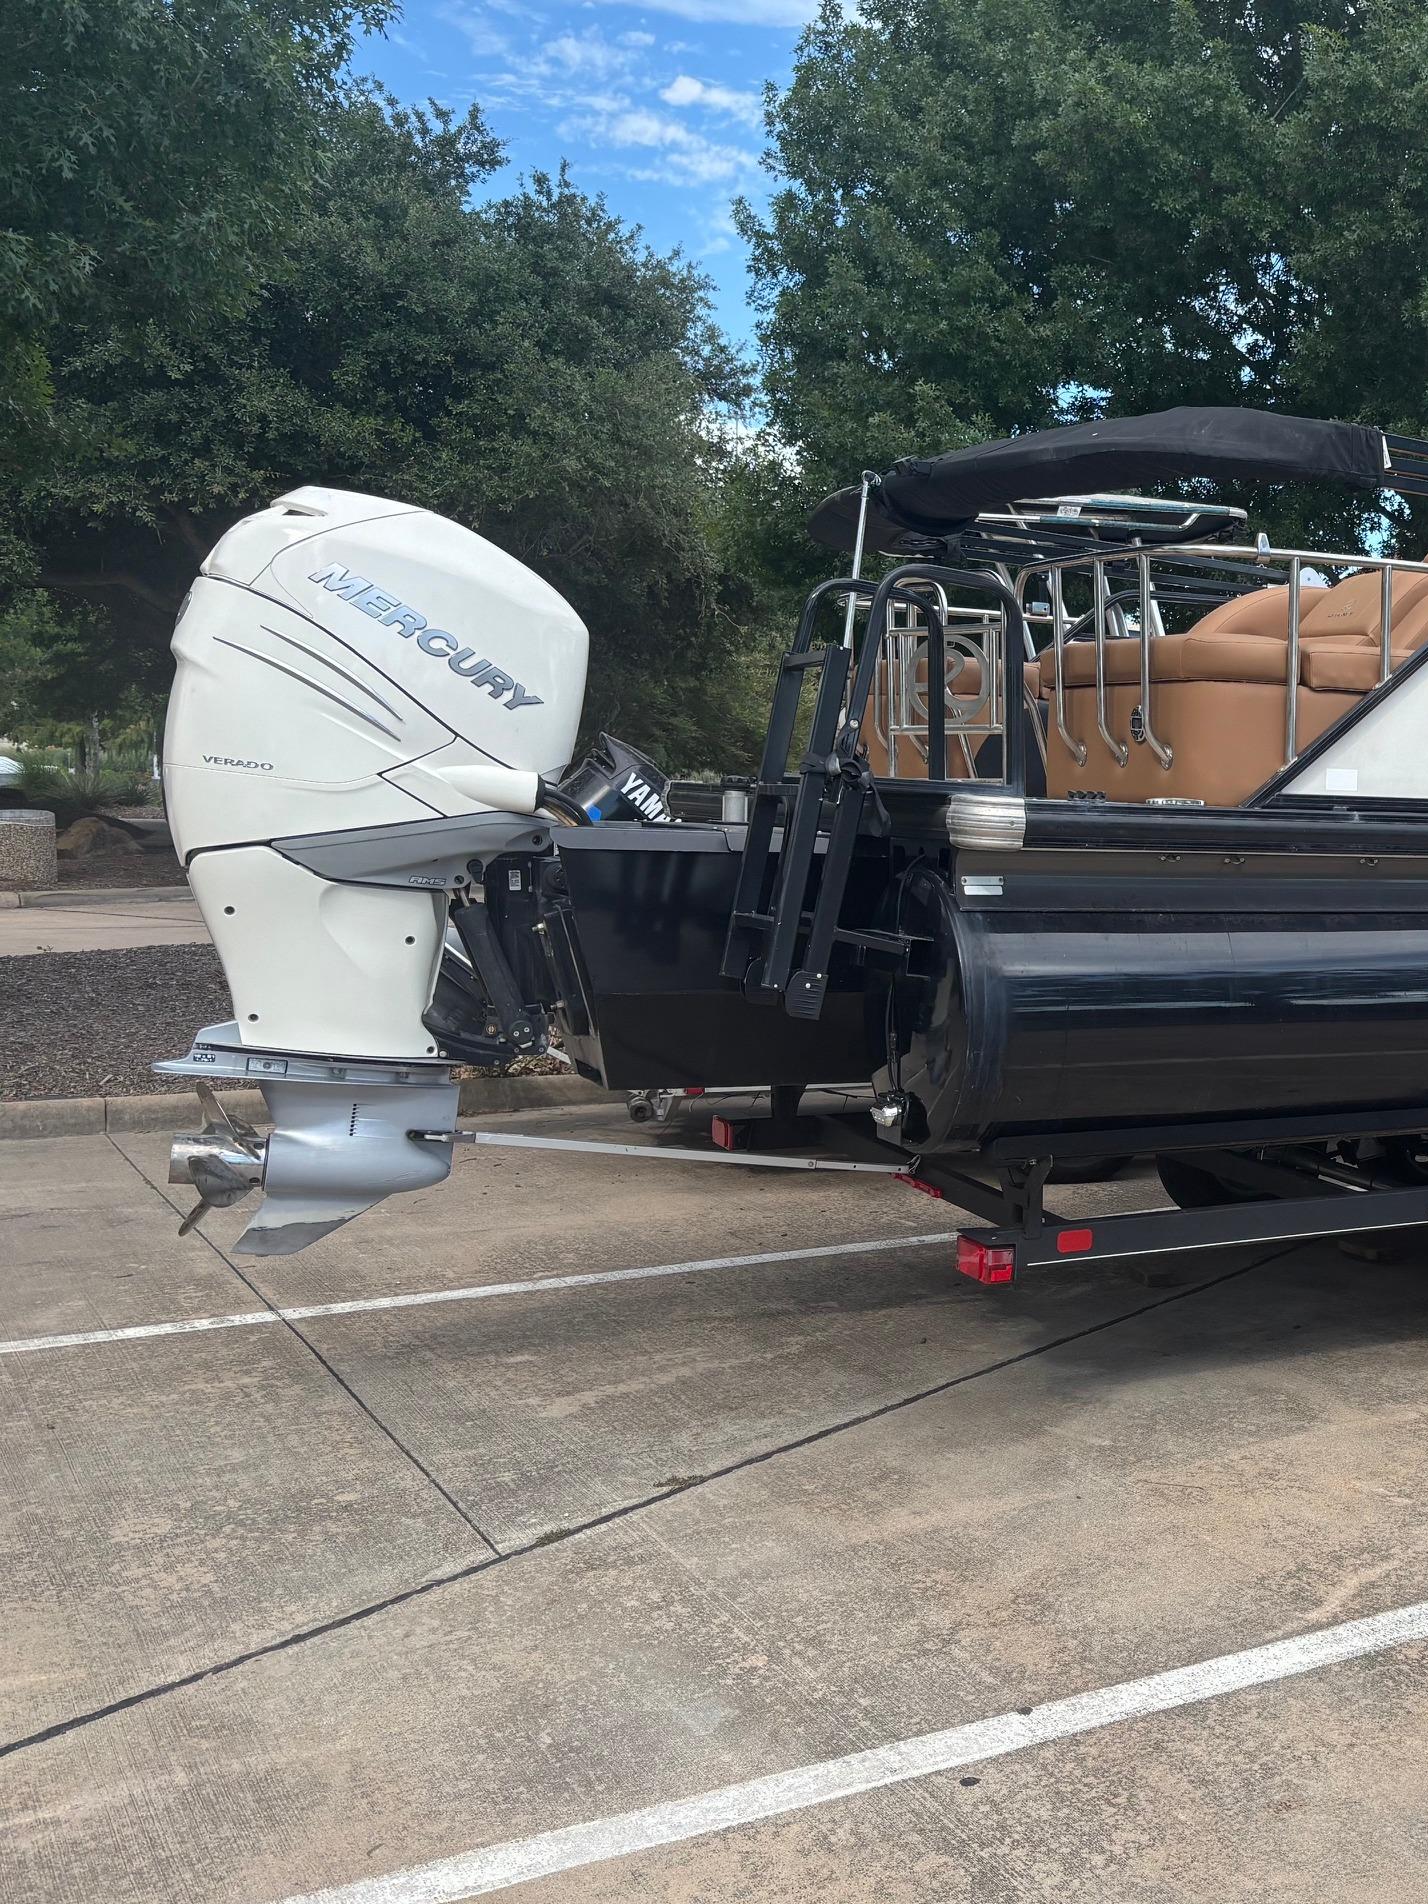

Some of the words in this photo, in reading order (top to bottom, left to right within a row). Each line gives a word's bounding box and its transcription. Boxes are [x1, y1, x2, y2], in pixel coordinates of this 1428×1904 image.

[307, 561, 544, 711] MERCURY
[202, 755, 274, 770] VERADO
[620, 772, 682, 822] YAM
